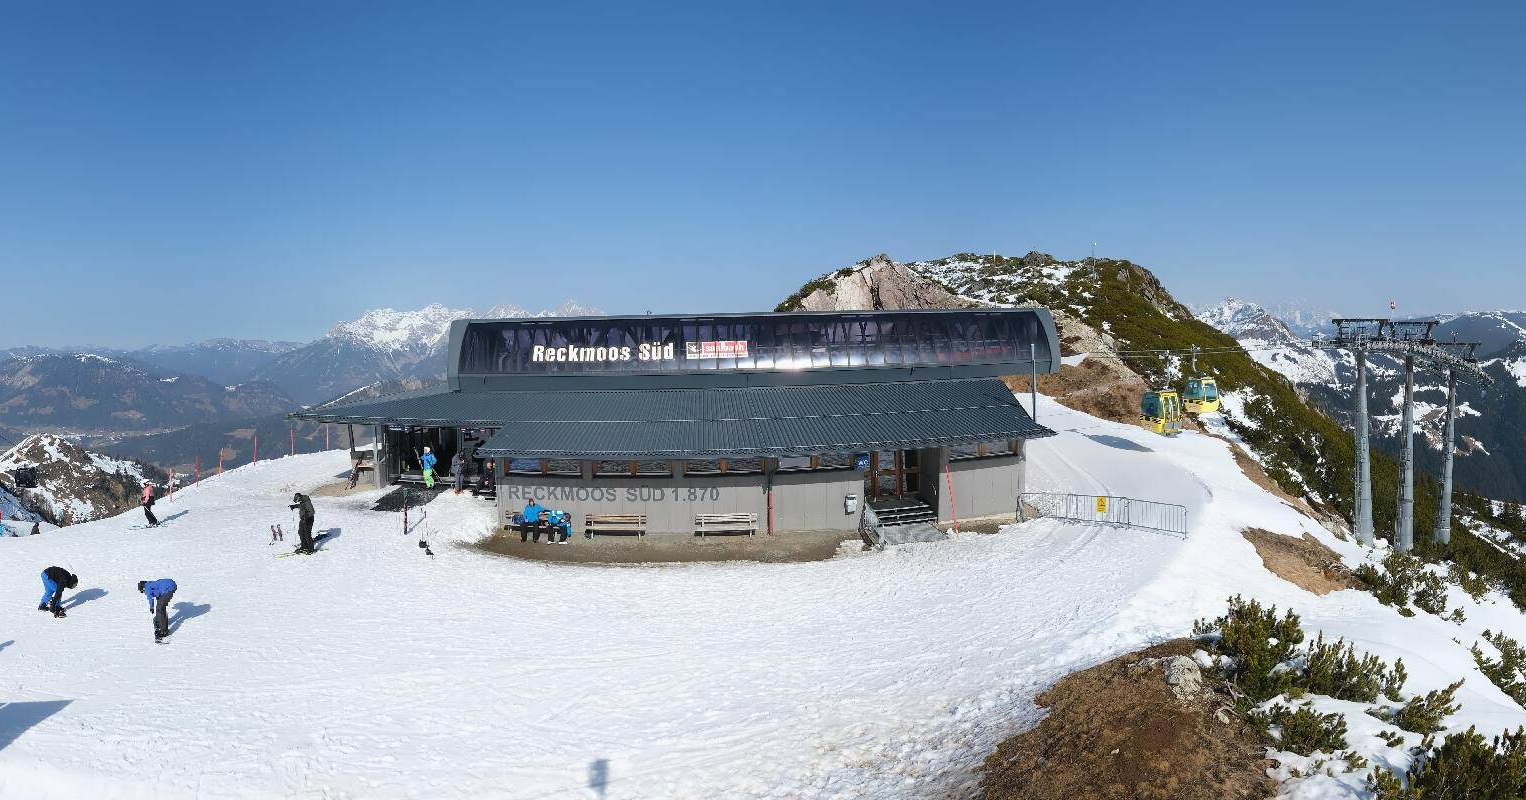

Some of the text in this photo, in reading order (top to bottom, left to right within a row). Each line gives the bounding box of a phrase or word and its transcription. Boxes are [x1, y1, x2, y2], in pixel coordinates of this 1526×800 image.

[533, 342, 674, 362] Reckmoos Süd
[508, 486, 617, 502] RECKMOOS
[672, 487, 720, 501] 1.870
